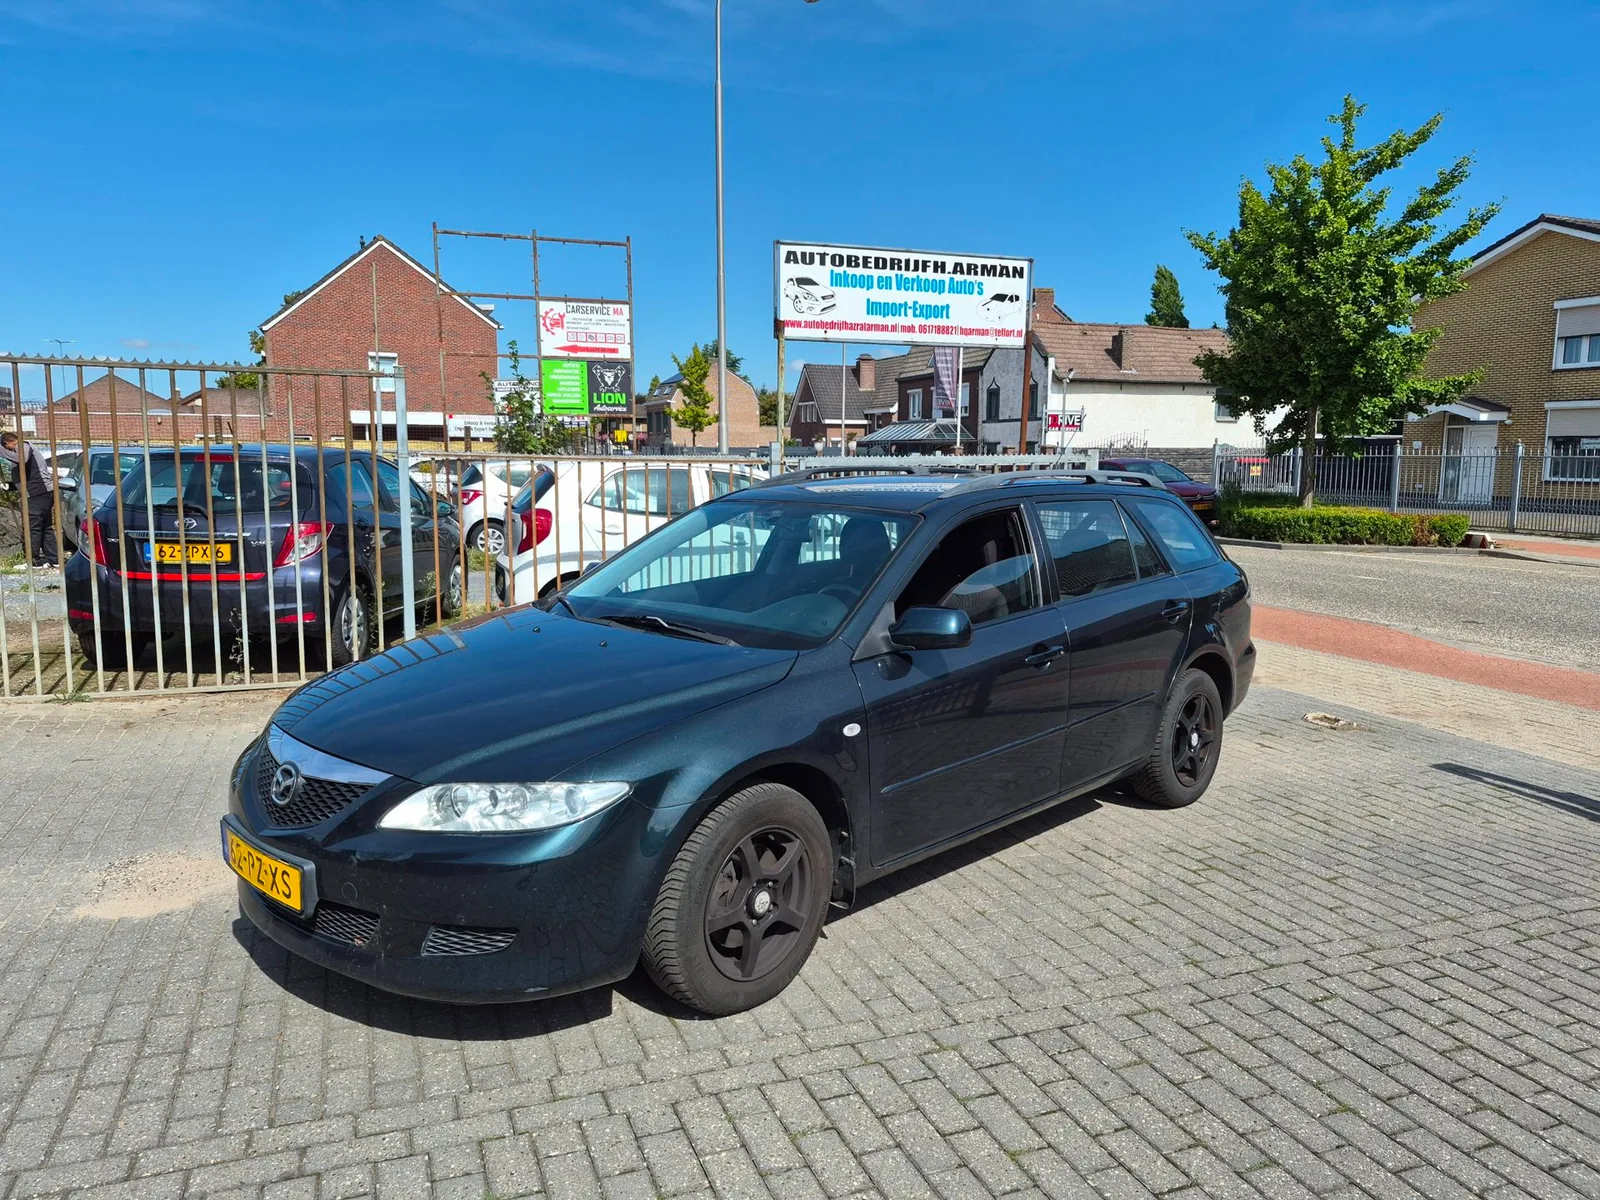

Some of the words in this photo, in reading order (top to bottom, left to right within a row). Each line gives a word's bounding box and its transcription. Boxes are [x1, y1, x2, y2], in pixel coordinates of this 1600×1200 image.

[784, 250, 1025, 279] AUTOBEDRIJFH.ARMAN
[829, 269, 874, 291] Inkoop
[877, 274, 893, 291] en
[895, 273, 946, 296] Verkoop
[947, 276, 984, 296] Auto's
[566, 304, 611, 316] CARSERVICE
[613, 307, 624, 316] MA
[866, 298, 950, 320] Import-Export
[900, 323, 917, 334] mob.
[593, 392, 627, 404] LION
[593, 404, 627, 412] Autoservice
[158, 545, 224, 559] 62-ZPX6
